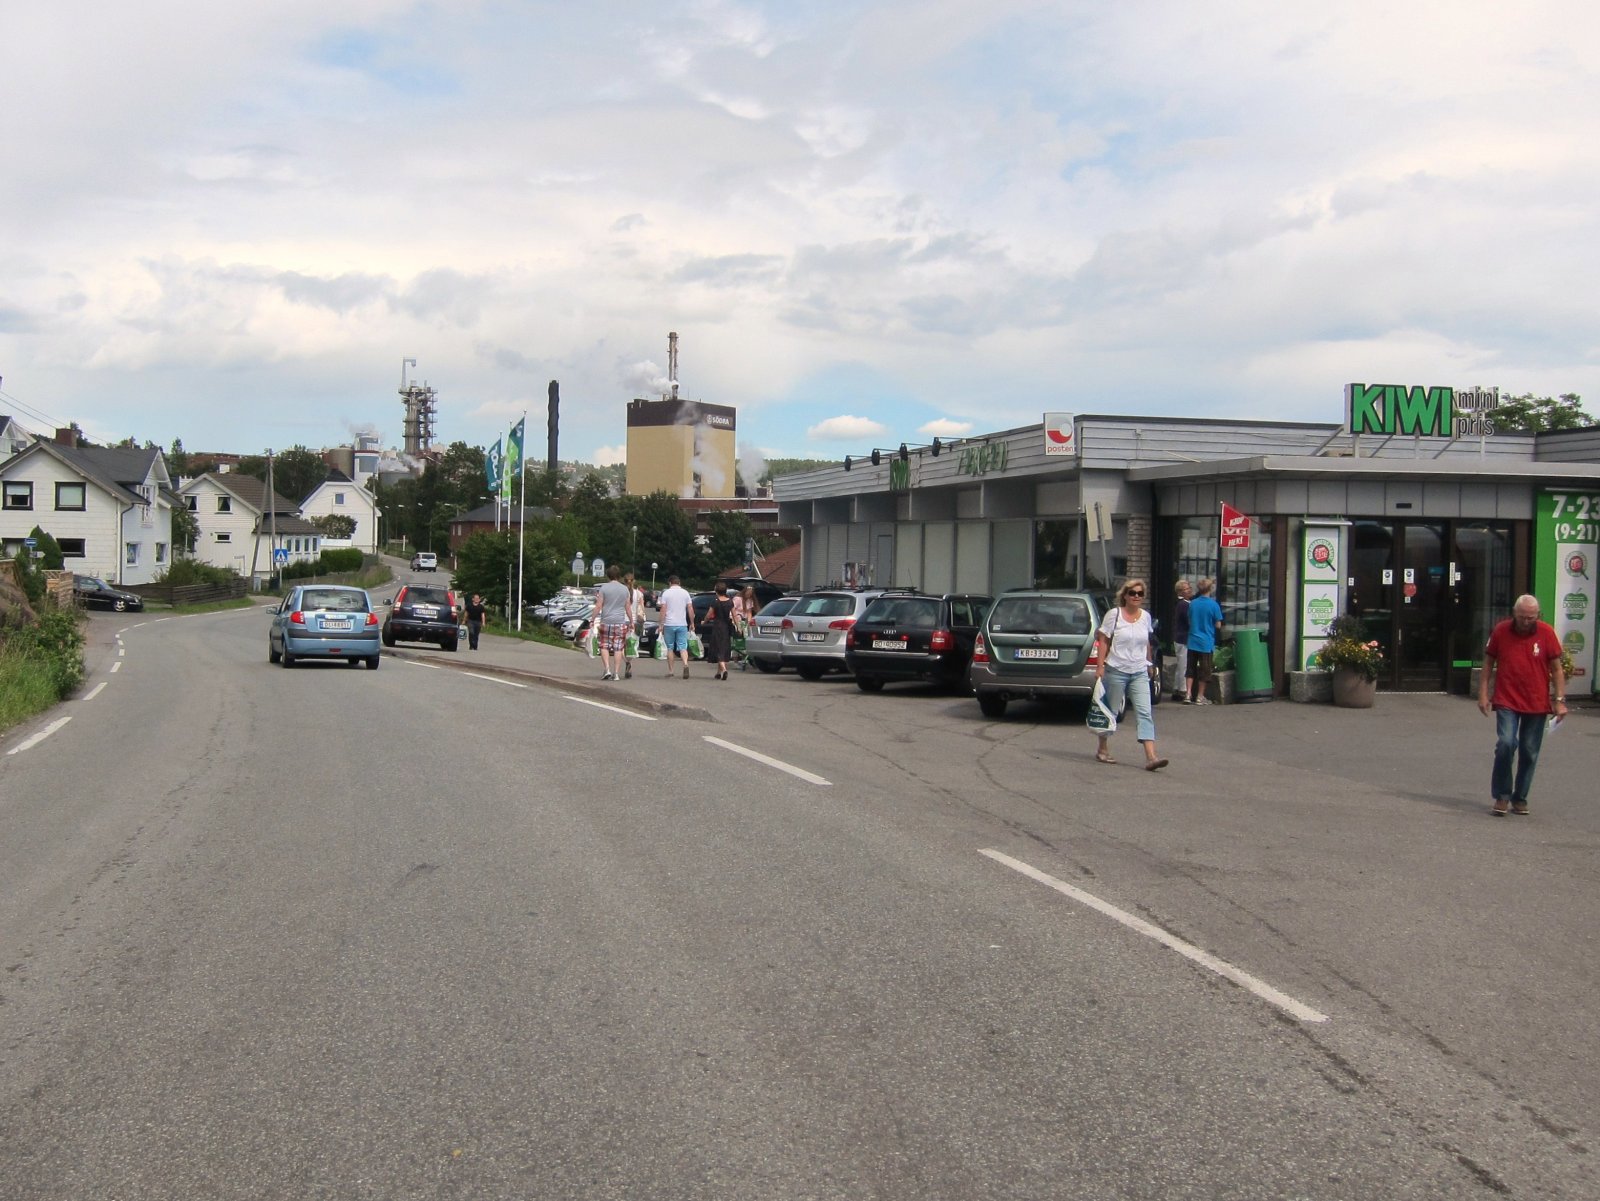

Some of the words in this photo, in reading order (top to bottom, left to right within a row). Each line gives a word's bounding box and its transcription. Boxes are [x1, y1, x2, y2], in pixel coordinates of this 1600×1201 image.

[1458, 385, 1500, 409] mini
[1350, 383, 1453, 437] KIWI
[1457, 411, 1495, 438] pris
[1047, 445, 1073, 454] posten
[1555, 523, 1599, 542] (9-21)
